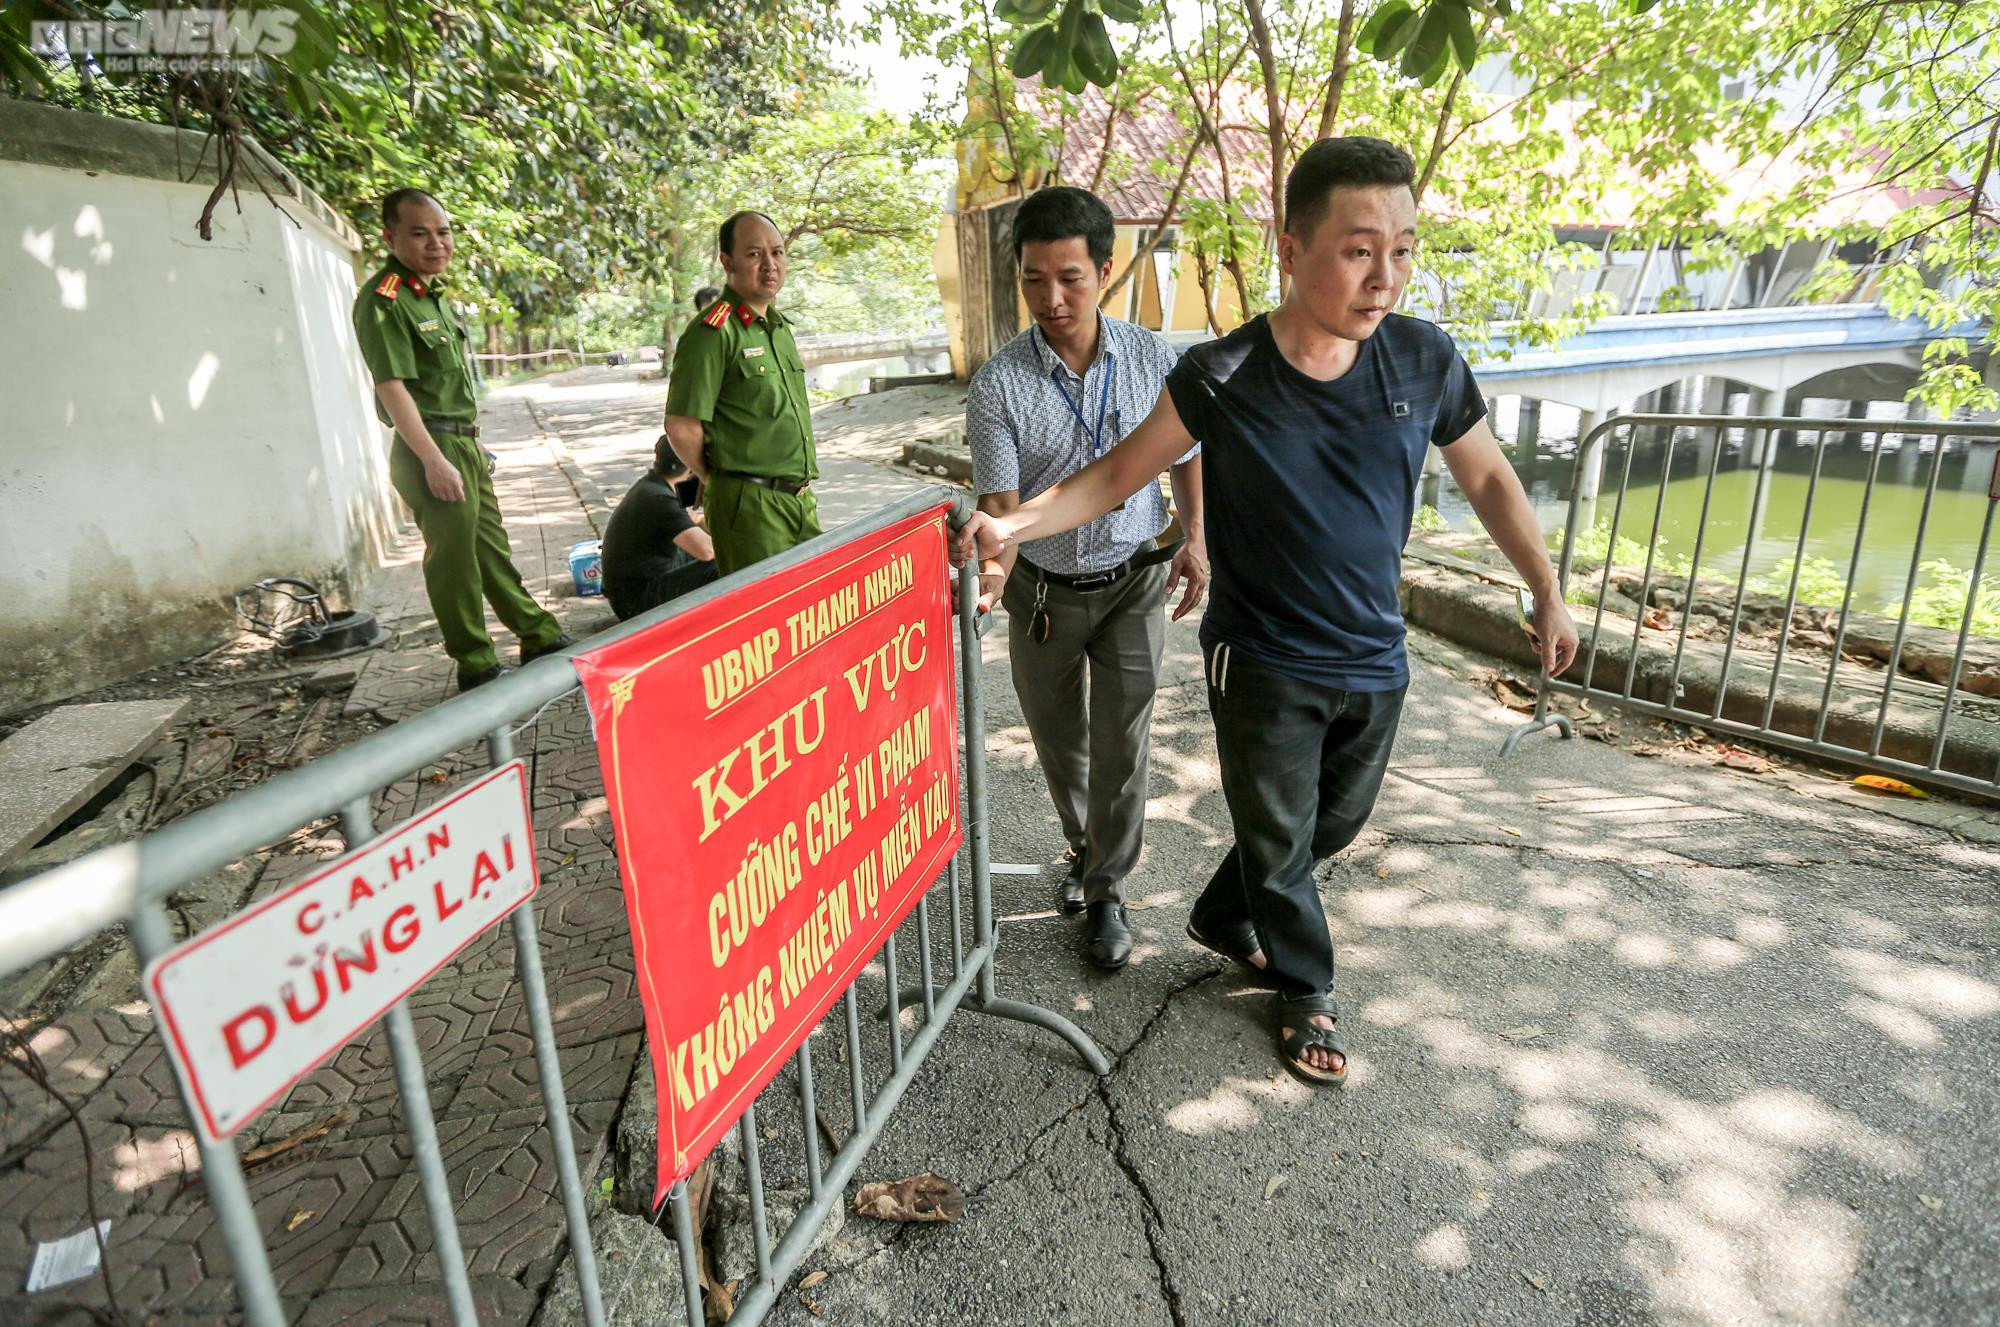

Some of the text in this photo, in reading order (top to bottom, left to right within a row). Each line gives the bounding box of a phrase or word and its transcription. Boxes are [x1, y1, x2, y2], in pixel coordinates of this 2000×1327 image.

[692, 618, 927, 843] KHU VỰC
[702, 552, 913, 710] UBNP THANH NHÀN
[296, 823, 451, 936] C.A.H.N
[671, 770, 950, 1112] KHÔNG NHIỆM VỤ MIỄN VÀO
[708, 704, 931, 968] CƯỠNG CHẾ VI PHẠM
[221, 834, 514, 1071] DỪNG LẠI
